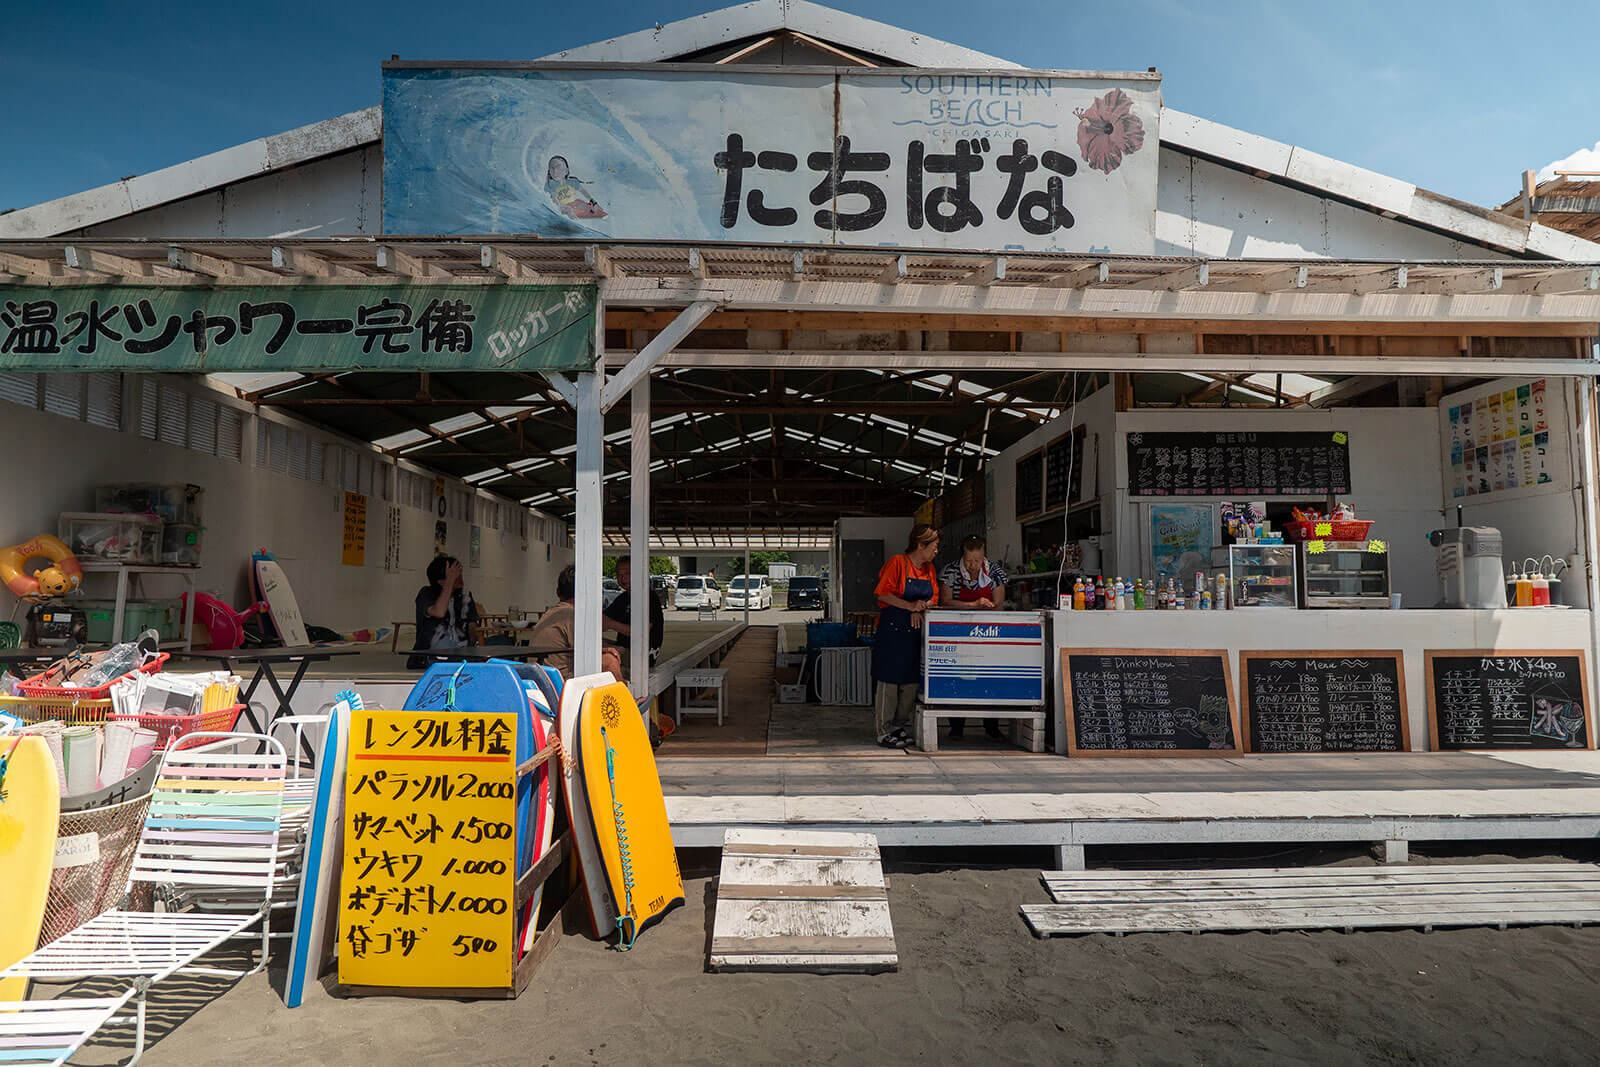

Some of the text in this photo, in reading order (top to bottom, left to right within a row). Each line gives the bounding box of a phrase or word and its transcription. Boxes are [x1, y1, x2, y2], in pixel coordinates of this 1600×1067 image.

[900, 74, 1052, 97] SOUTHERN
[929, 99, 1023, 124] BEACH
[931, 128, 1019, 138] CHIGASAKI
[714, 133, 1078, 236] たちばな
[1215, 433, 1257, 444] MENU
[970, 625, 999, 639] Asahi
[1305, 660, 1337, 671] Menu
[1481, 657, 1557, 673] かき氷 ¥400
[1254, 673, 1317, 683] ラーメン ¥800
[1444, 669, 1476, 678] イチゴ
[1446, 679, 1476, 687] メロン
[1328, 694, 1358, 702] カレー
[1488, 687, 1519, 695] カルピス
[364, 718, 512, 755] レンタル料金
[352, 770, 455, 802] パラソル
[353, 847, 423, 883] ウキワ
[648, 895, 665, 912] TEAM
[452, 934, 498, 957] 500
